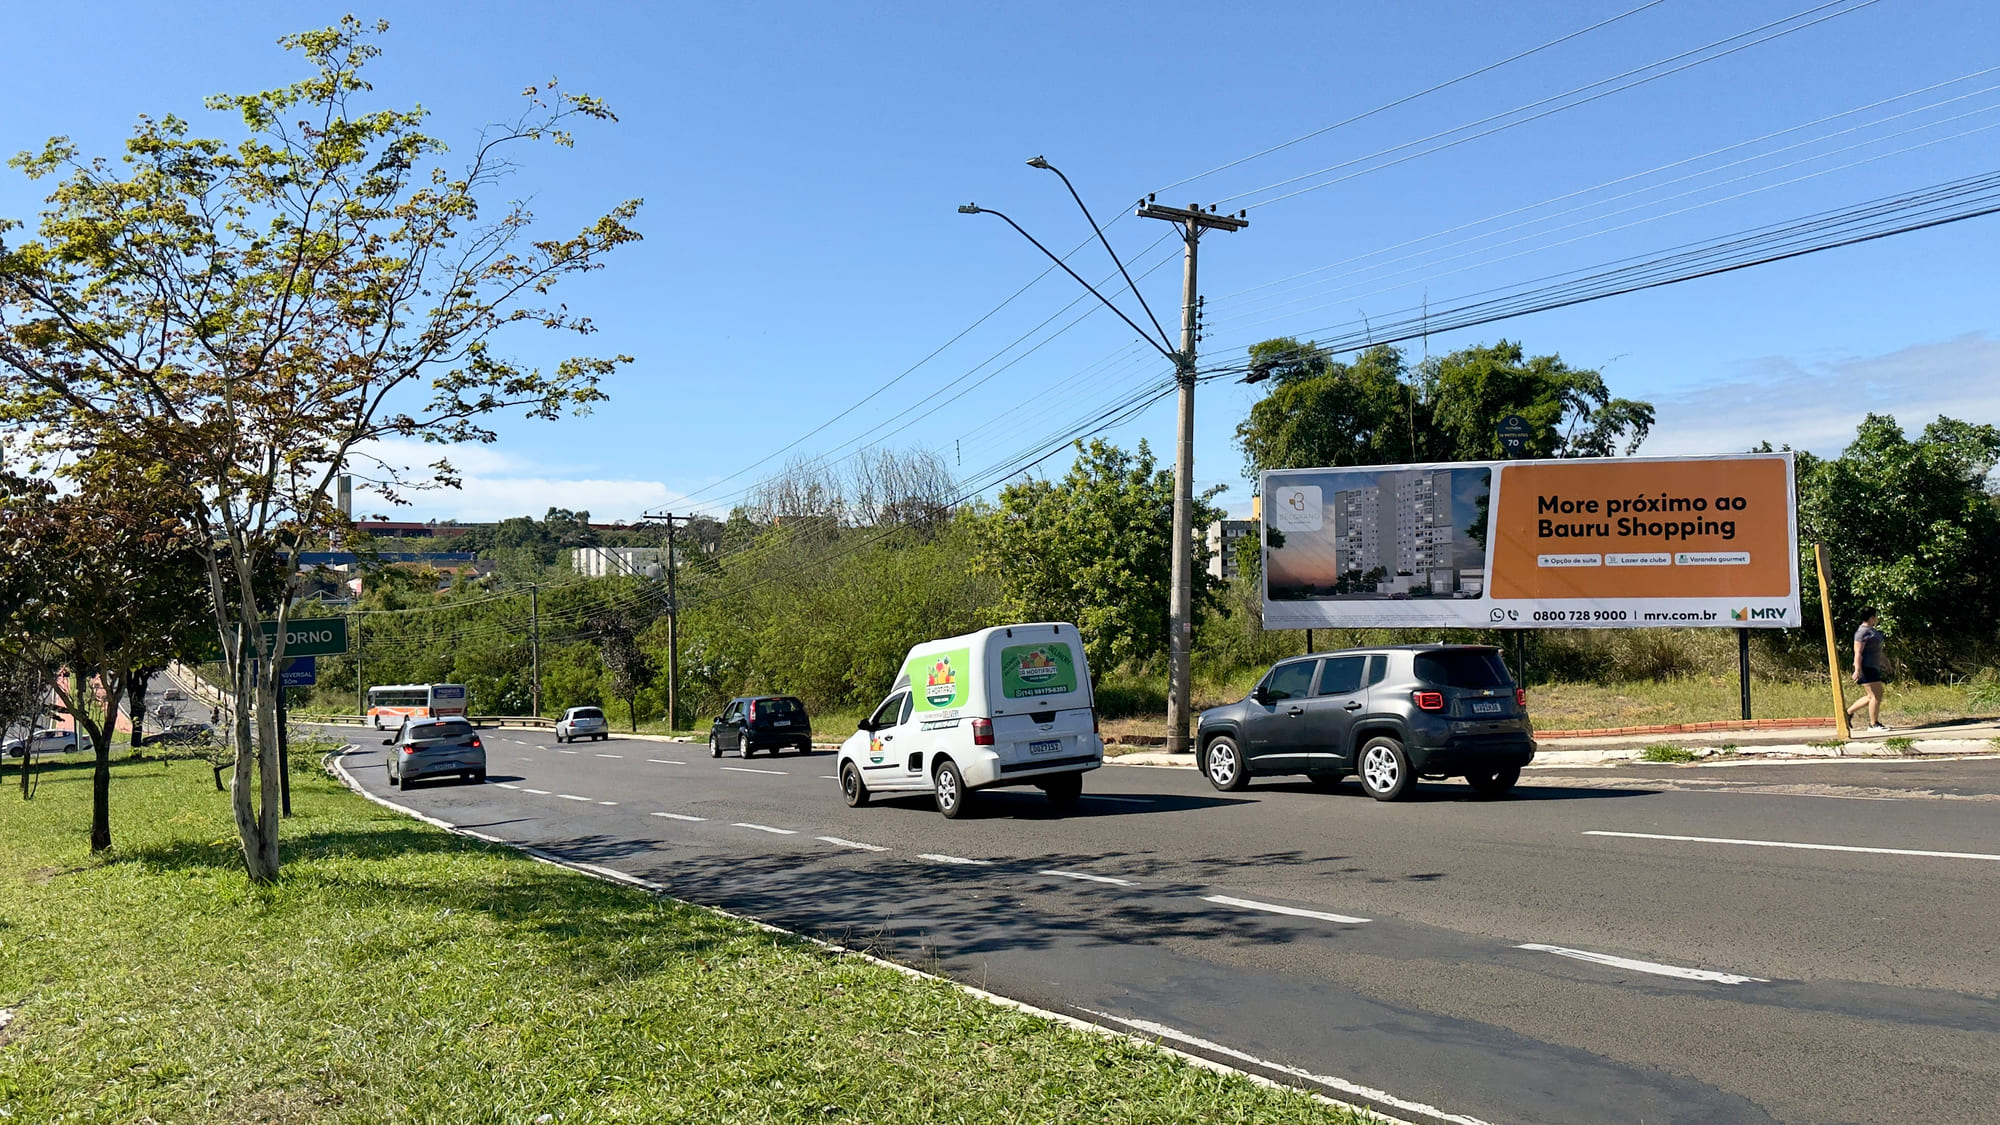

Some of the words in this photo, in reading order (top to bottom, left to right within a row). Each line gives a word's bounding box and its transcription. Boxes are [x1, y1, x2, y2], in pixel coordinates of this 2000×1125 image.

[1507, 439, 1519, 447] 70
[1538, 495, 1599, 514] More
[1607, 493, 1707, 518] próximo
[1715, 496, 1747, 511] ao
[1538, 518, 1610, 538] Bauru
[1617, 516, 1736, 540] Shopping
[1533, 611, 1566, 621] 0800
[1569, 611, 1591, 620] 728
[1594, 610, 1627, 620] 9000
[1644, 610, 1717, 620] mrv.com.br
[1751, 608, 1787, 619] MRV
[251, 630, 332, 647] EORNO
